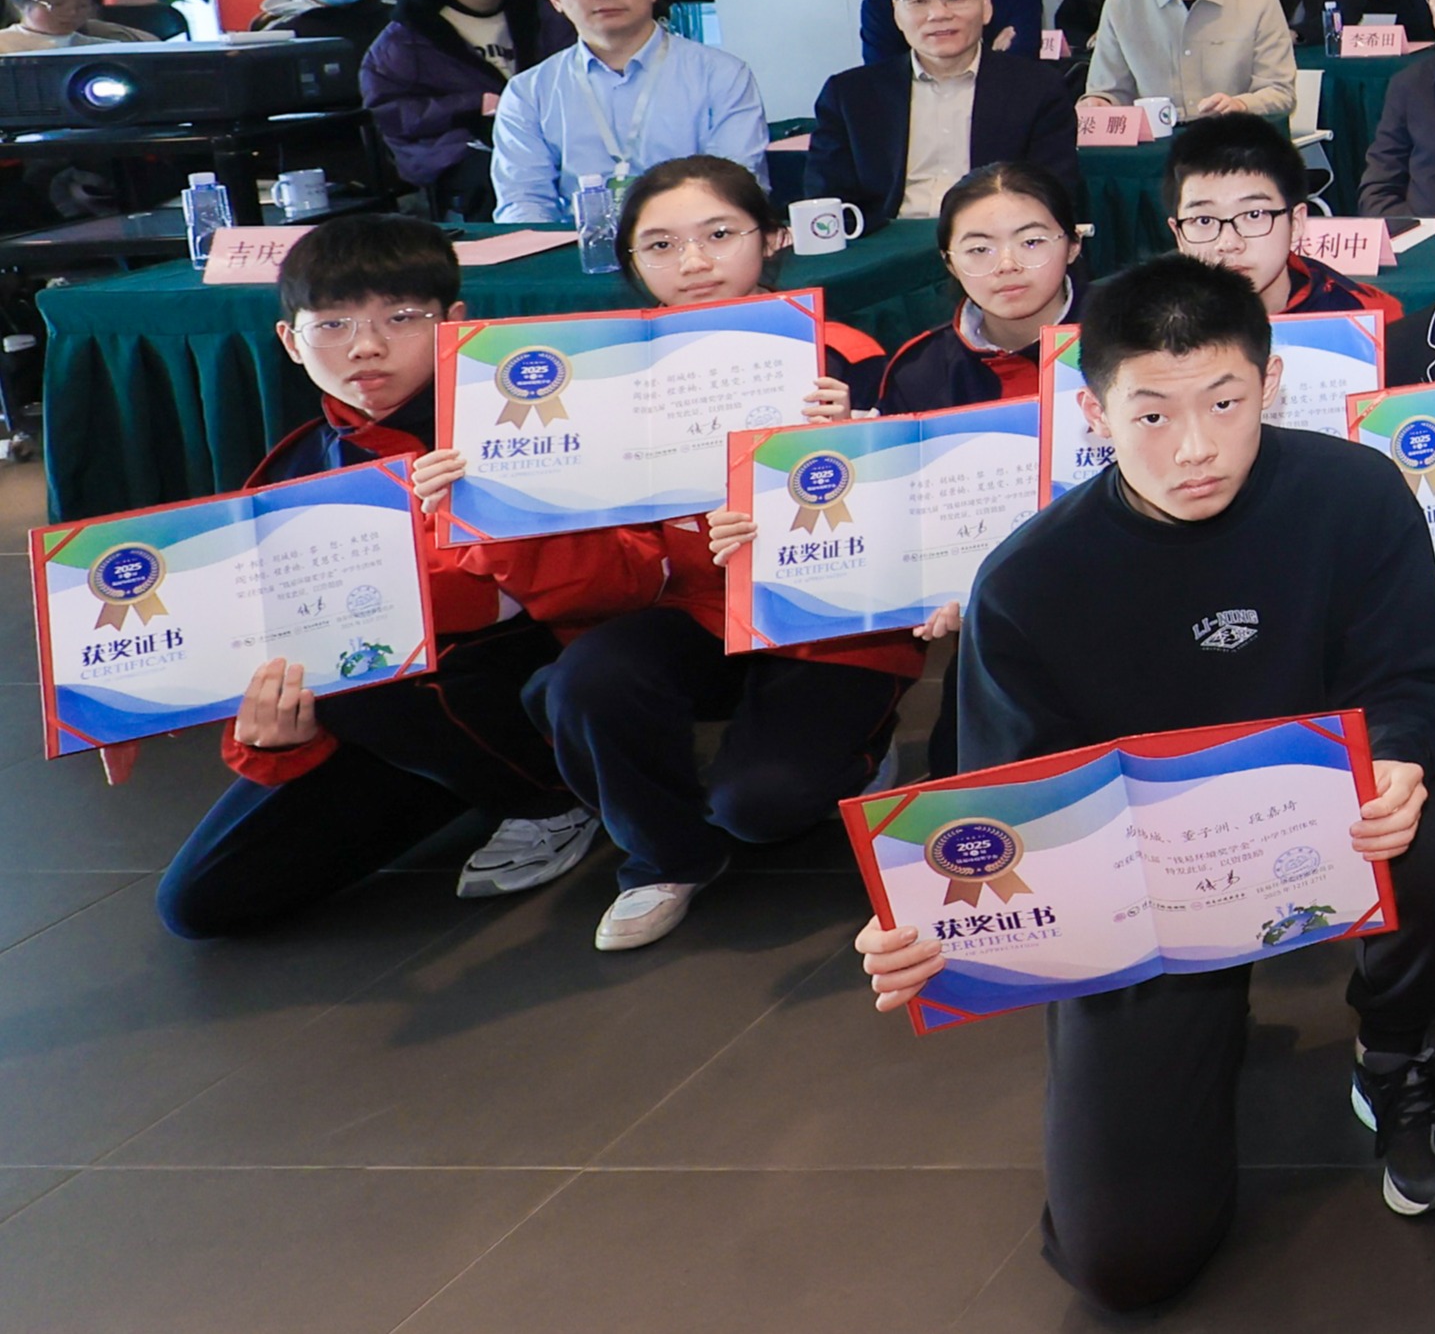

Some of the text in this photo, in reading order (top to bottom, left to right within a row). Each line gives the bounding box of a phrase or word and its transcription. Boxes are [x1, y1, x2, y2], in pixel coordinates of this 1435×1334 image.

[481, 433, 581, 461] 获奖证书
[1076, 446, 1118, 468] 获奖
[477, 455, 581, 474] CERTIFICATE
[778, 536, 864, 566] 获奖证书
[775, 557, 866, 580] CERTIFICATE
[81, 627, 184, 667] 获奖证书
[80, 650, 187, 681] CERTIFICATE
[957, 840, 991, 852] 2025
[932, 904, 1057, 941] 获奖证书
[940, 927, 1063, 954] CERTIFICATE
[976, 941, 1039, 955] APPRECIATION
